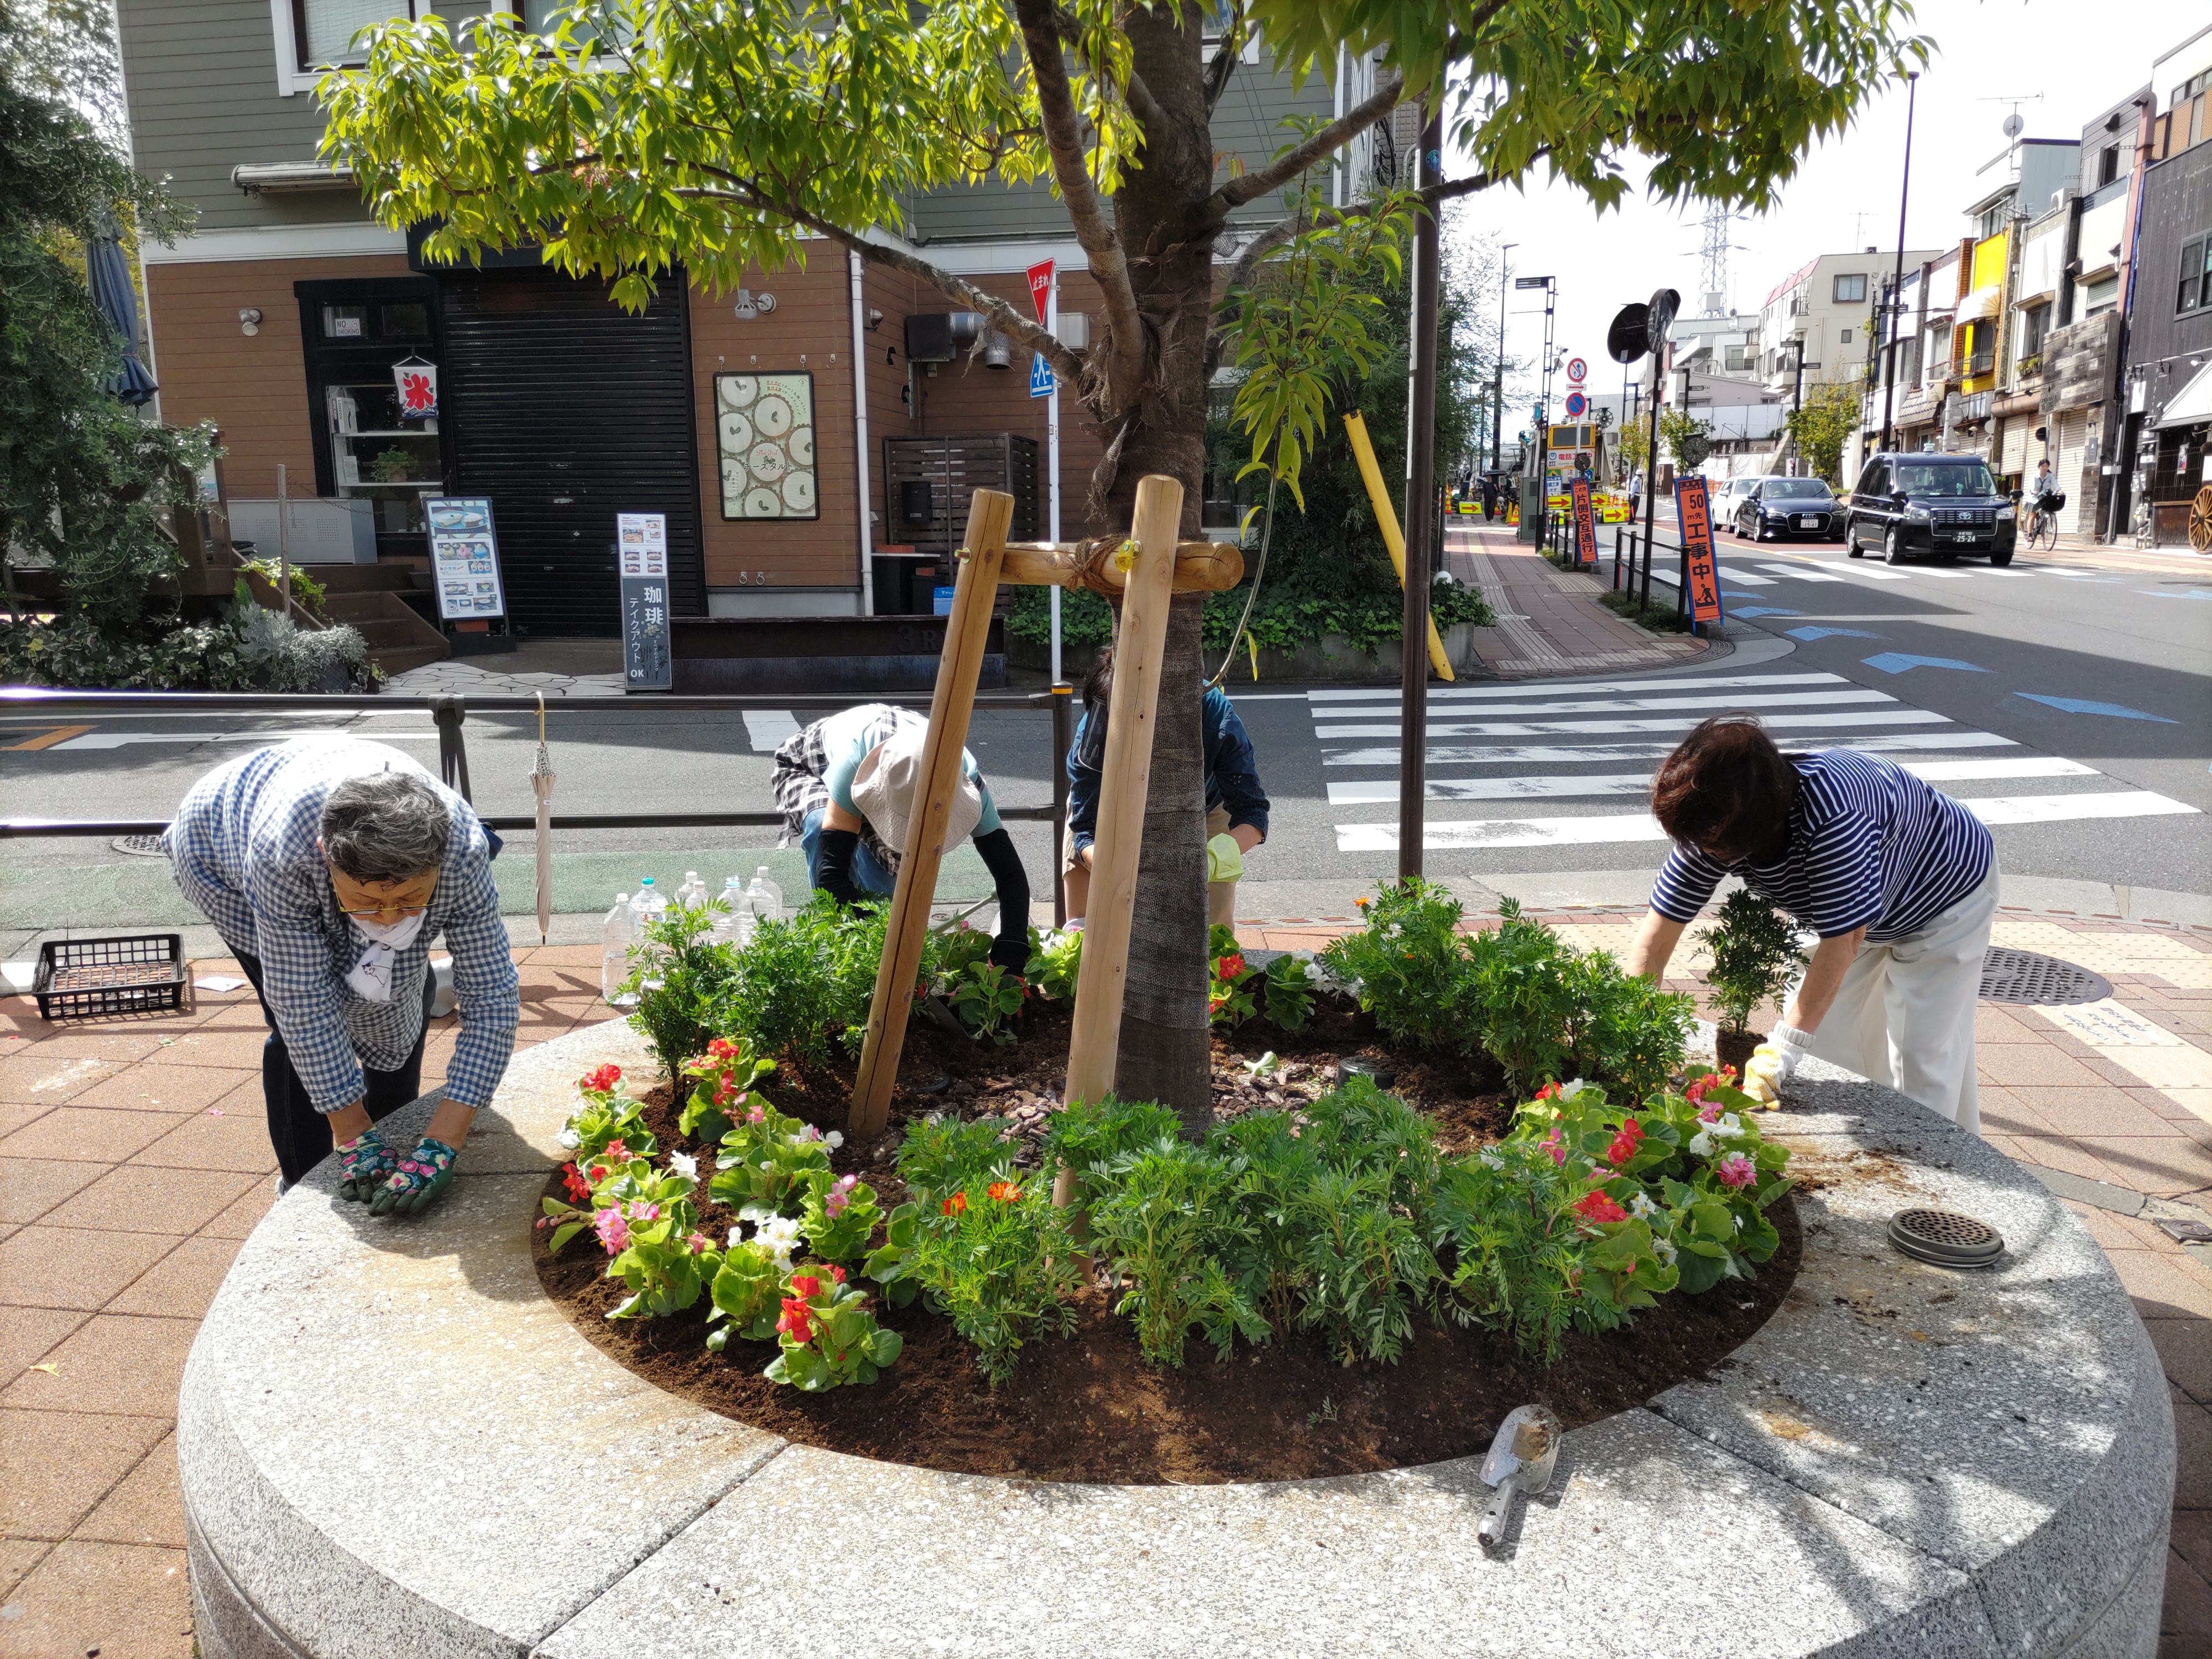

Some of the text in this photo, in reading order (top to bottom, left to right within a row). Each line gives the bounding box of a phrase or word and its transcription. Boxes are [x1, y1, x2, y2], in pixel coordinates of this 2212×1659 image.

[1032, 273, 1049, 291] 止まれ
[403, 373, 434, 410] 氷
[744, 462, 792, 472] チーズタルト
[1689, 494, 1704, 509] 50
[1577, 494, 1593, 553] 片側交互通行
[1687, 512, 1703, 520] m先
[1687, 523, 1710, 580] 工事中
[644, 586, 664, 625] 珈琲
[629, 598, 641, 664] テイクアウト
[630, 669, 645, 677] OK
